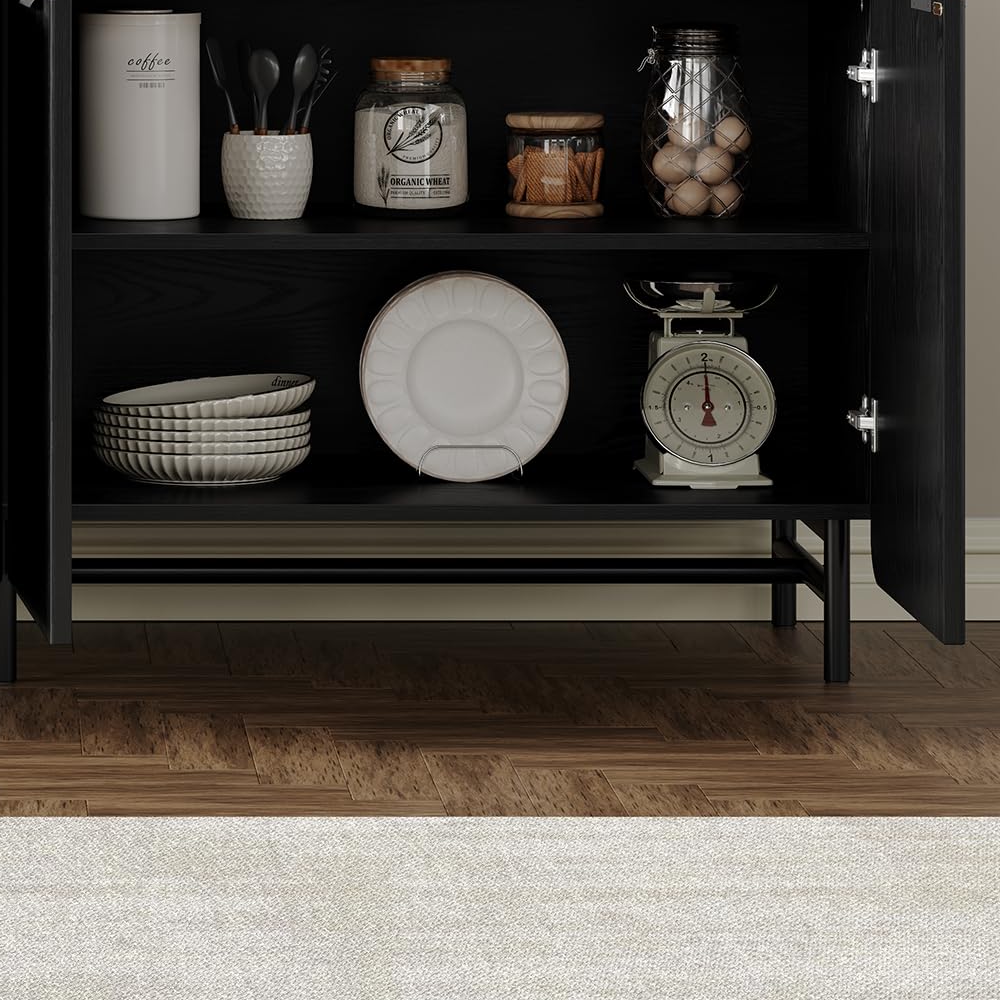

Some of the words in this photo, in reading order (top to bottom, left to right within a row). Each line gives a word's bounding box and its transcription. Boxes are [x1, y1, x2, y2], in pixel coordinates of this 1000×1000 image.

[127, 52, 172, 71] coffee
[390, 177, 425, 186] ORGANIC
[425, 177, 450, 186] WHEAT
